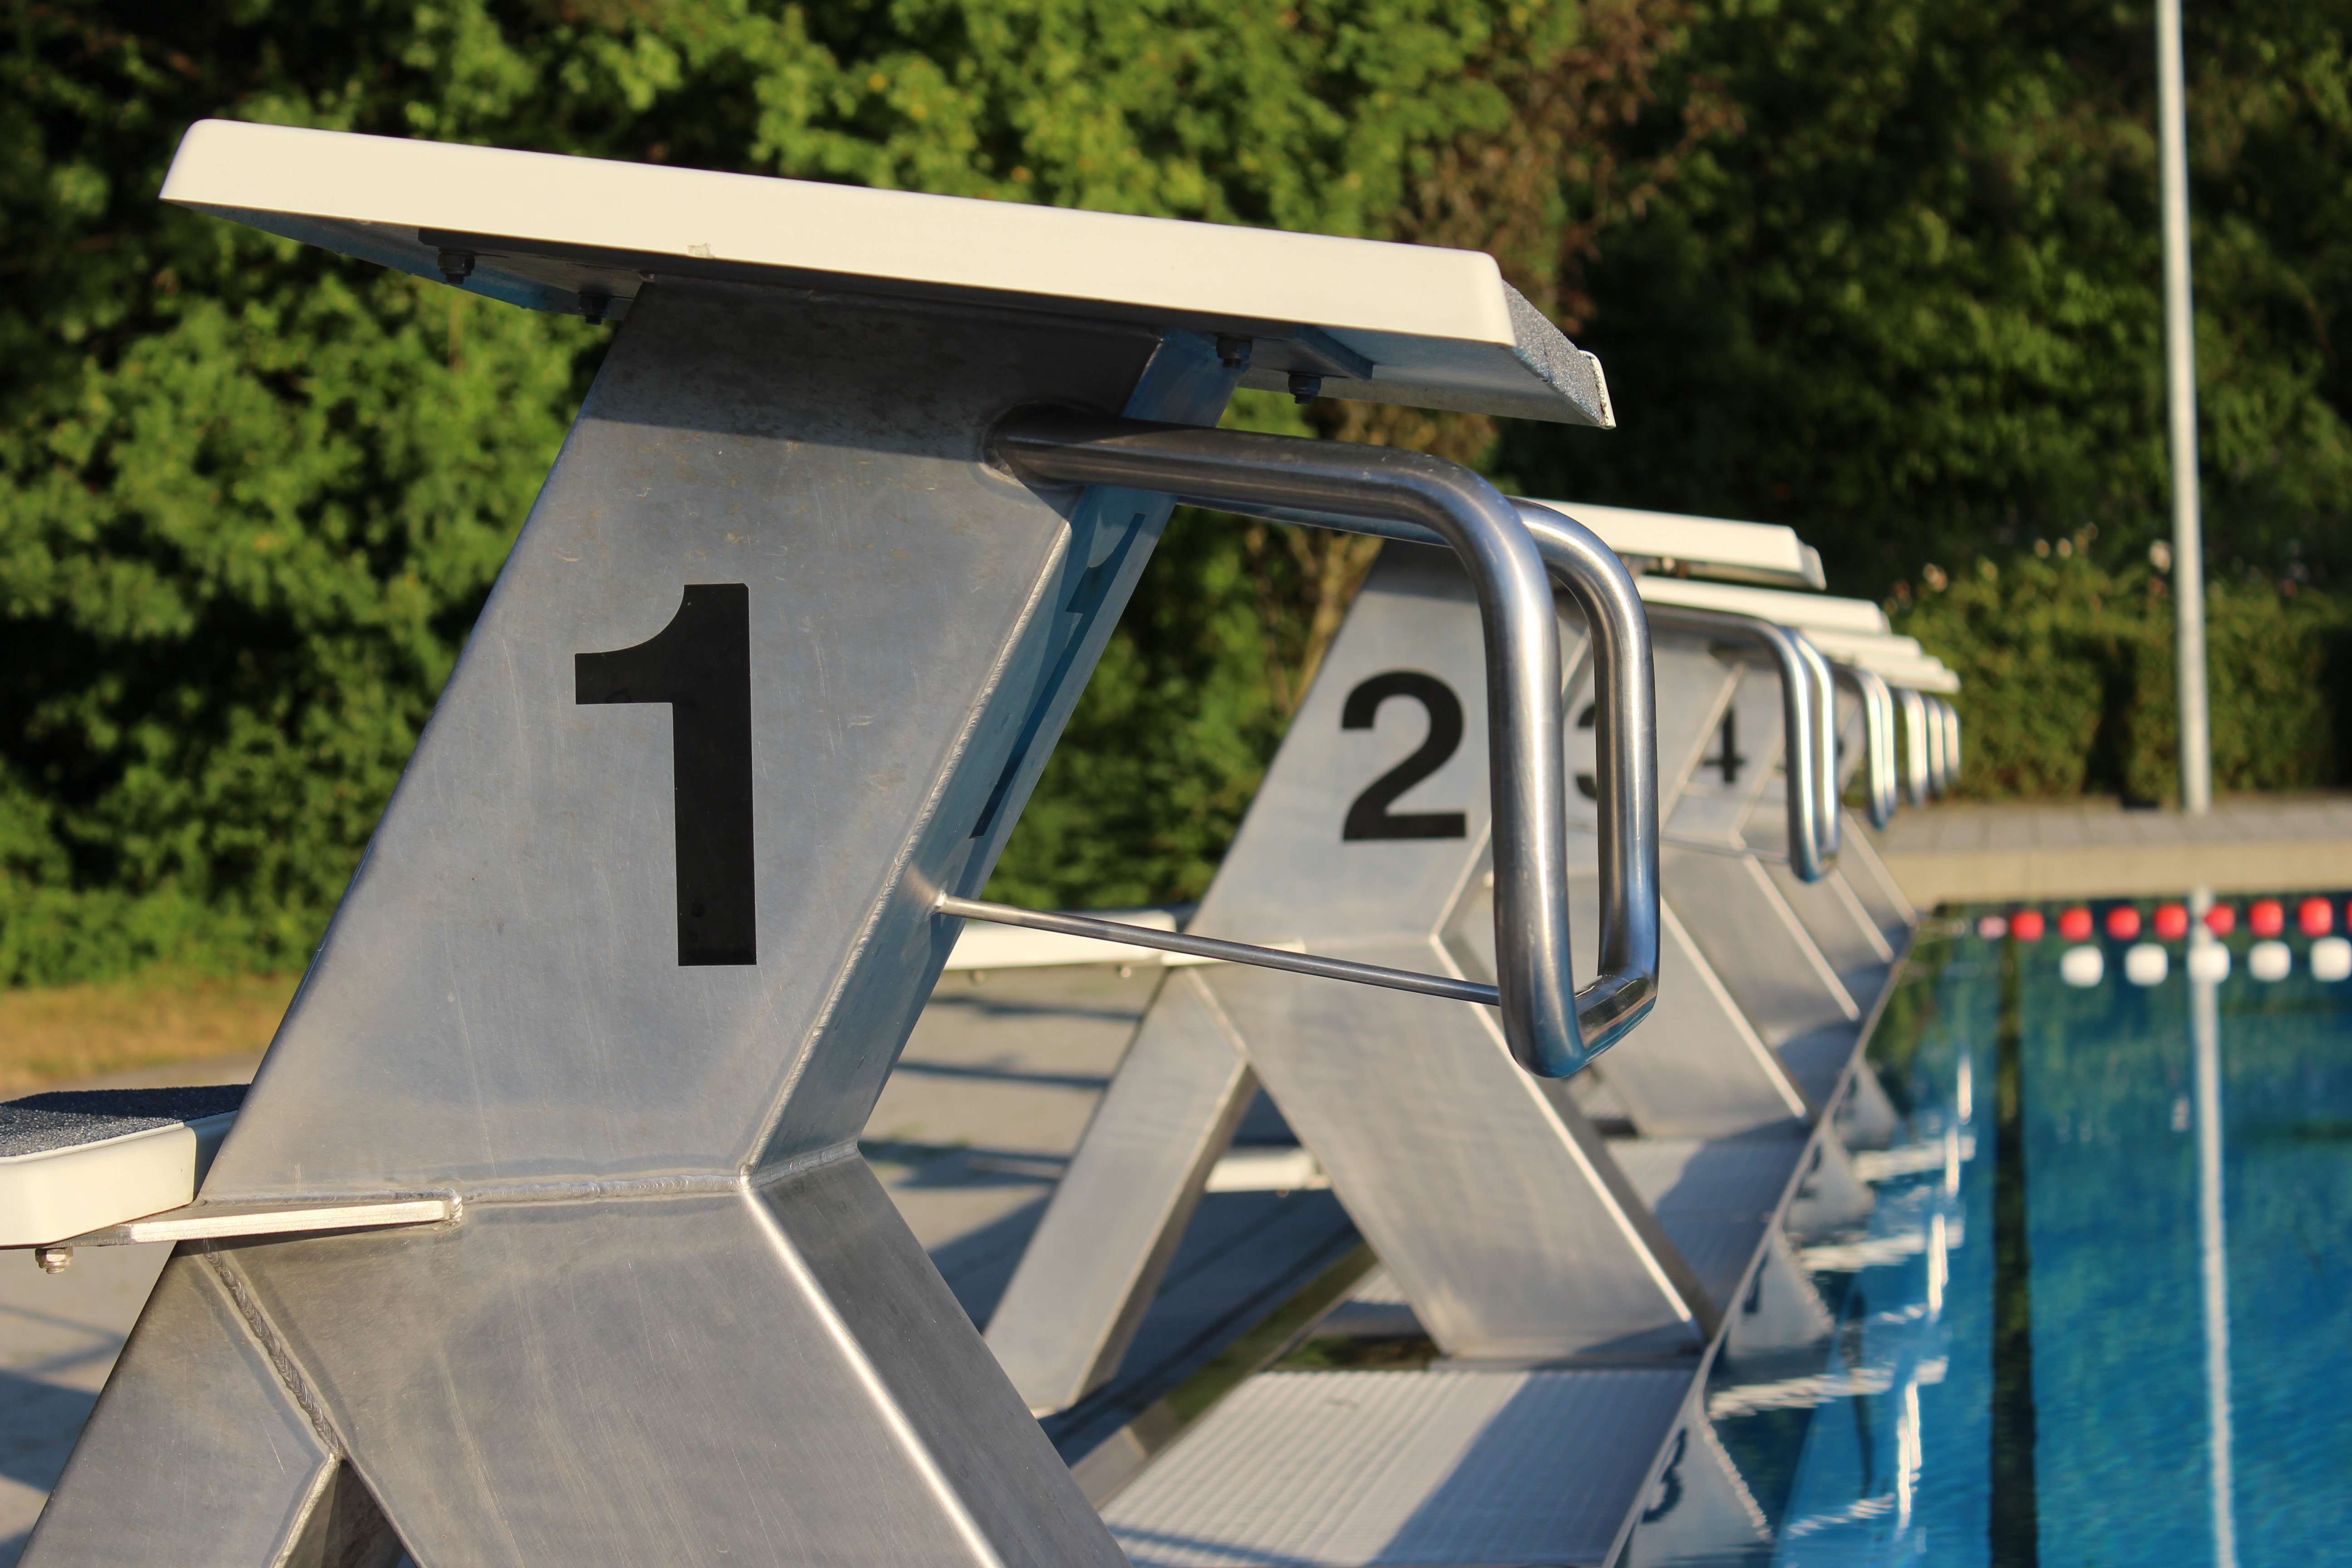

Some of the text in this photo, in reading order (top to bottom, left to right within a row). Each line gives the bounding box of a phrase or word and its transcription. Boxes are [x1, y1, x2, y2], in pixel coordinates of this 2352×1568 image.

[575, 583, 756, 966] 1
[1342, 671, 1466, 842] 2
[1701, 706, 1746, 783] 4
